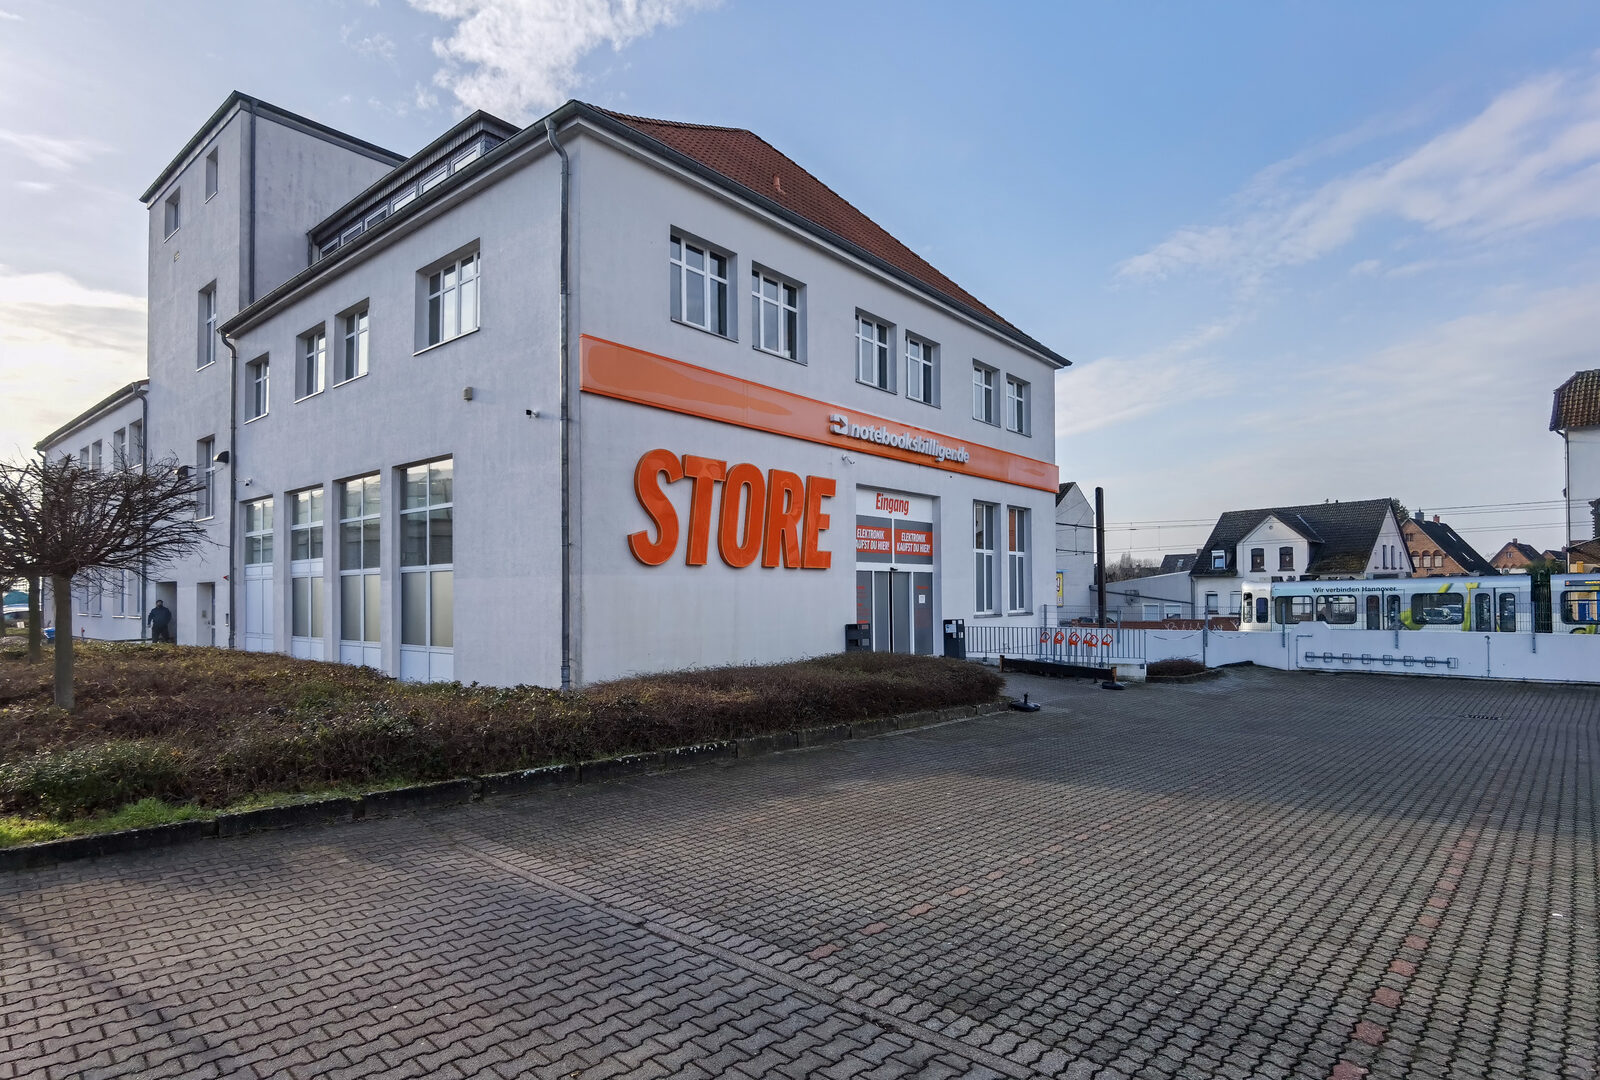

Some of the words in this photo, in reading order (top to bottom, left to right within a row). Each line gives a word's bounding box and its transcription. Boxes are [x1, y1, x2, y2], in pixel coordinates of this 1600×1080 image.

[848, 423, 970, 463] notebooksbilliger.de
[627, 448, 836, 569] STORE
[876, 492, 909, 515] Eingang
[856, 528, 885, 540] ELEKTRONIK
[901, 532, 926, 543] ELEKTRONIK
[856, 540, 870, 550] AUFST
[870, 540, 877, 550] DU
[896, 542, 912, 552] KAUFST
[913, 543, 920, 553] DU
